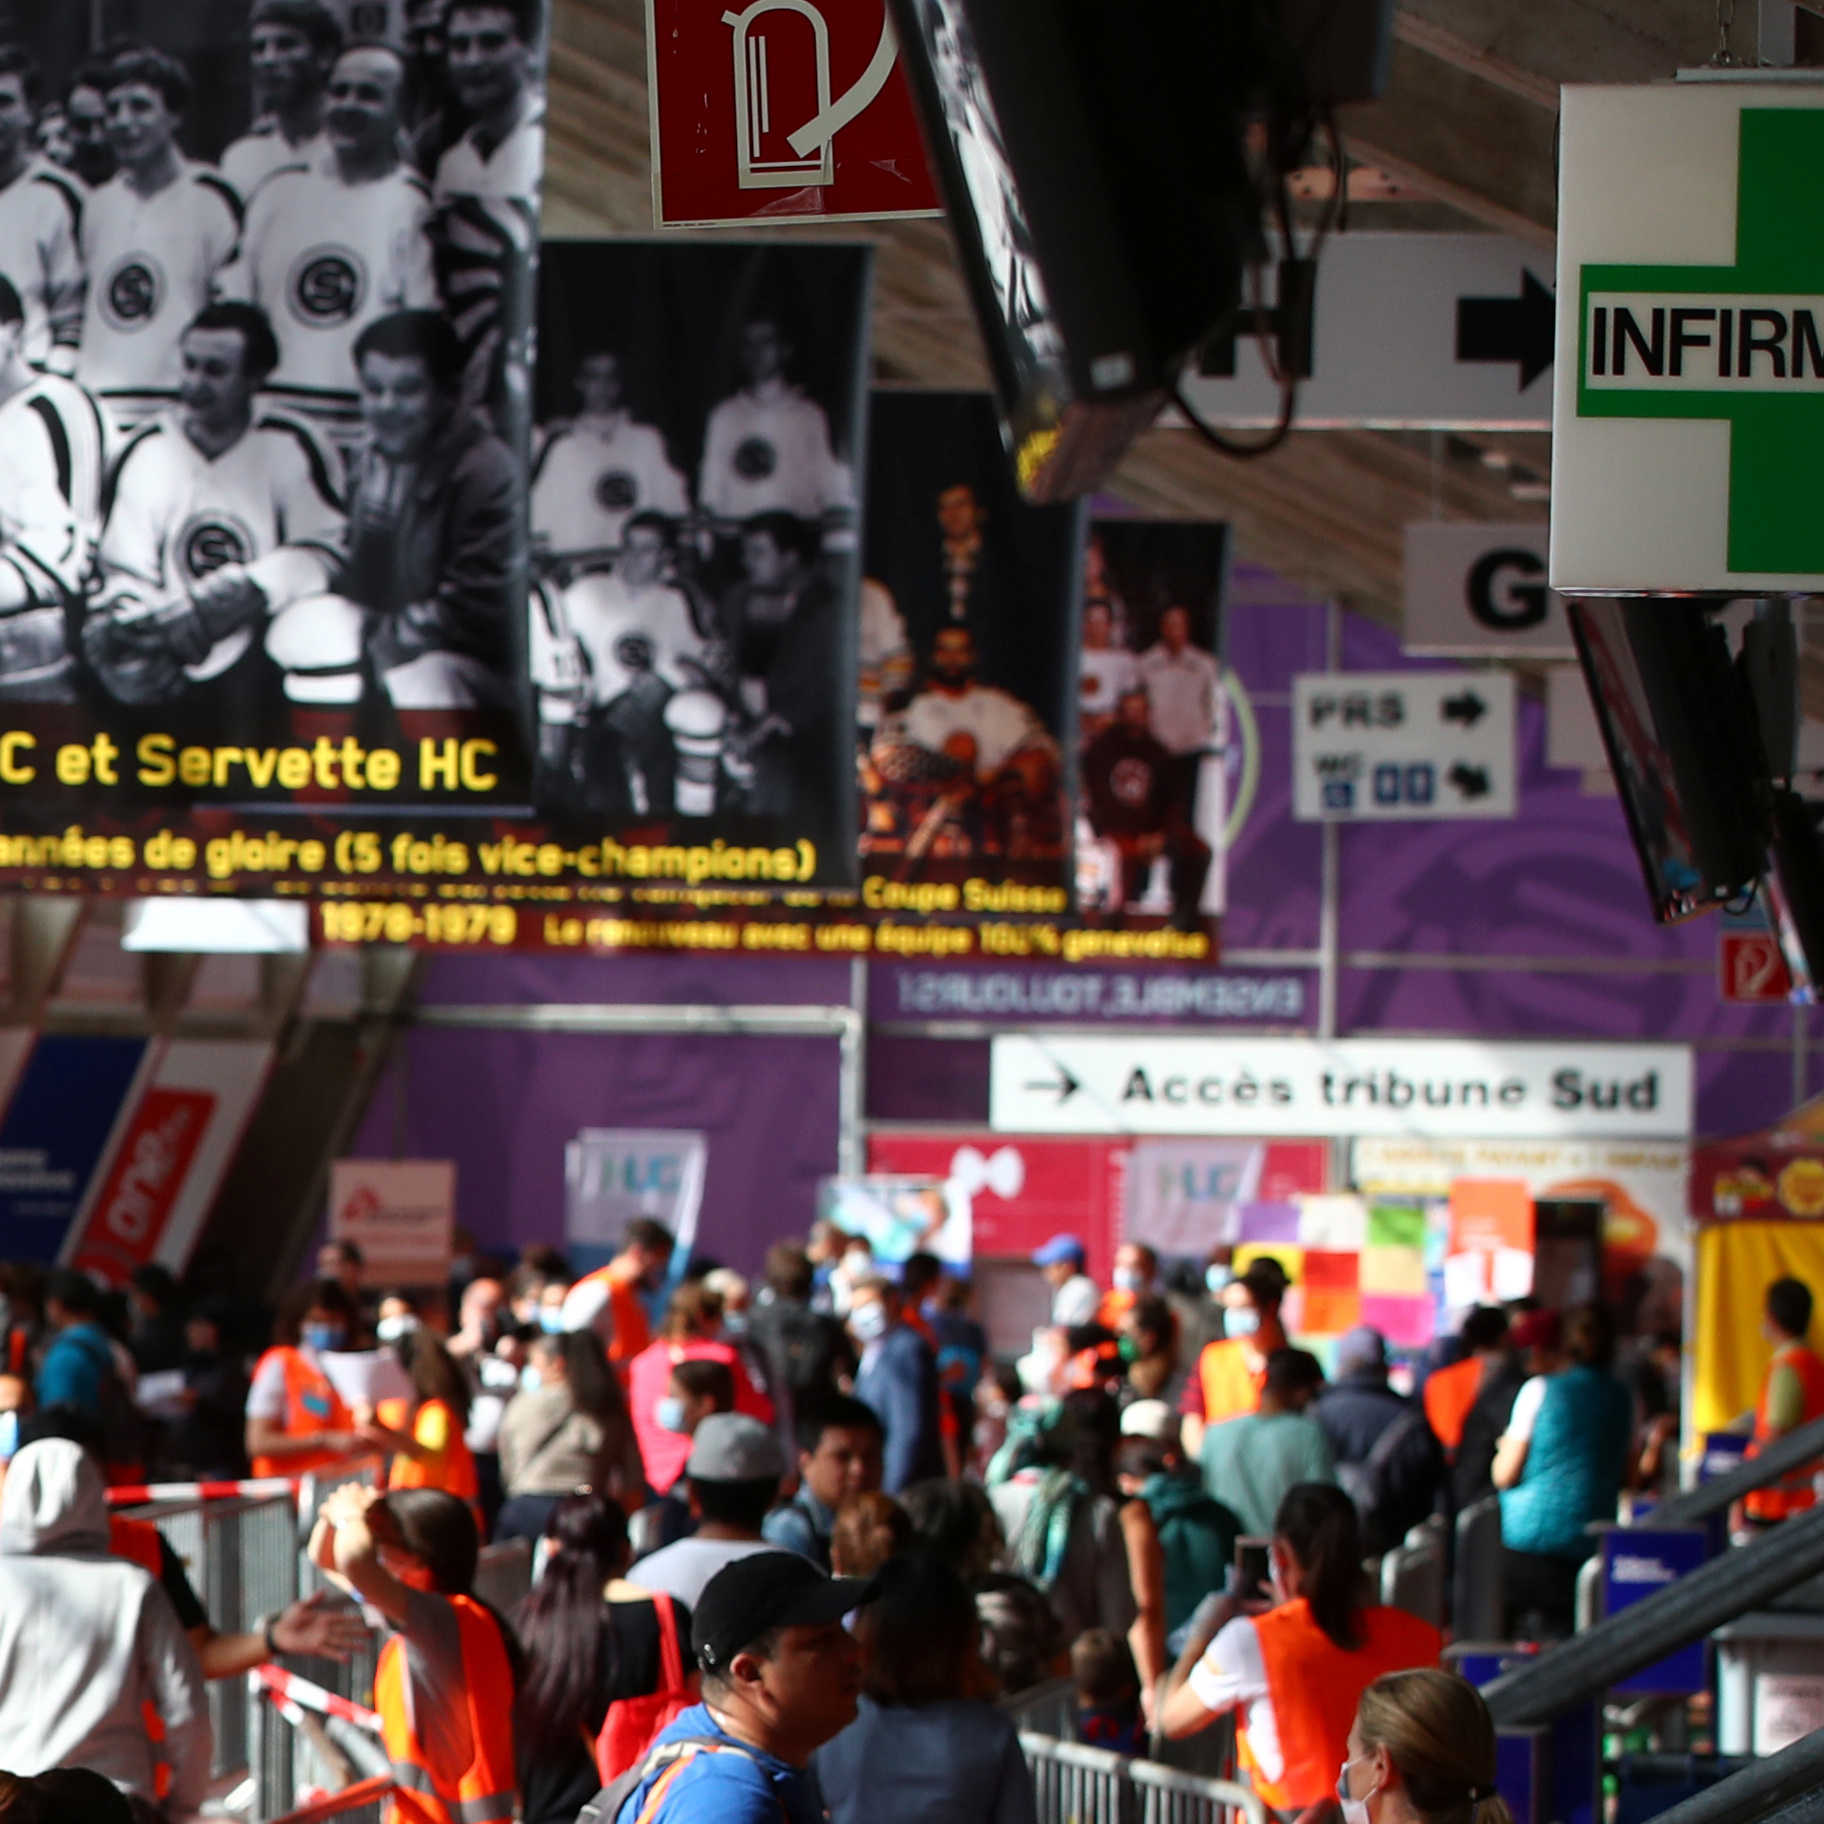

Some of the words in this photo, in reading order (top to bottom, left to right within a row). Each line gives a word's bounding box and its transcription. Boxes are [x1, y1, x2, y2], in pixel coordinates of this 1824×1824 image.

[57, 733, 118, 784] et
[138, 734, 400, 789] Servette
[420, 739, 496, 790] HC
[144, 830, 196, 869] de
[206, 831, 325, 882] gloire
[392, 833, 469, 874] fois
[479, 838, 816, 884] vice-champions)
[1120, 1066, 1292, 1106] Accès
[1322, 1067, 1527, 1108] tribune
[1552, 1070, 1660, 1110] Sud
